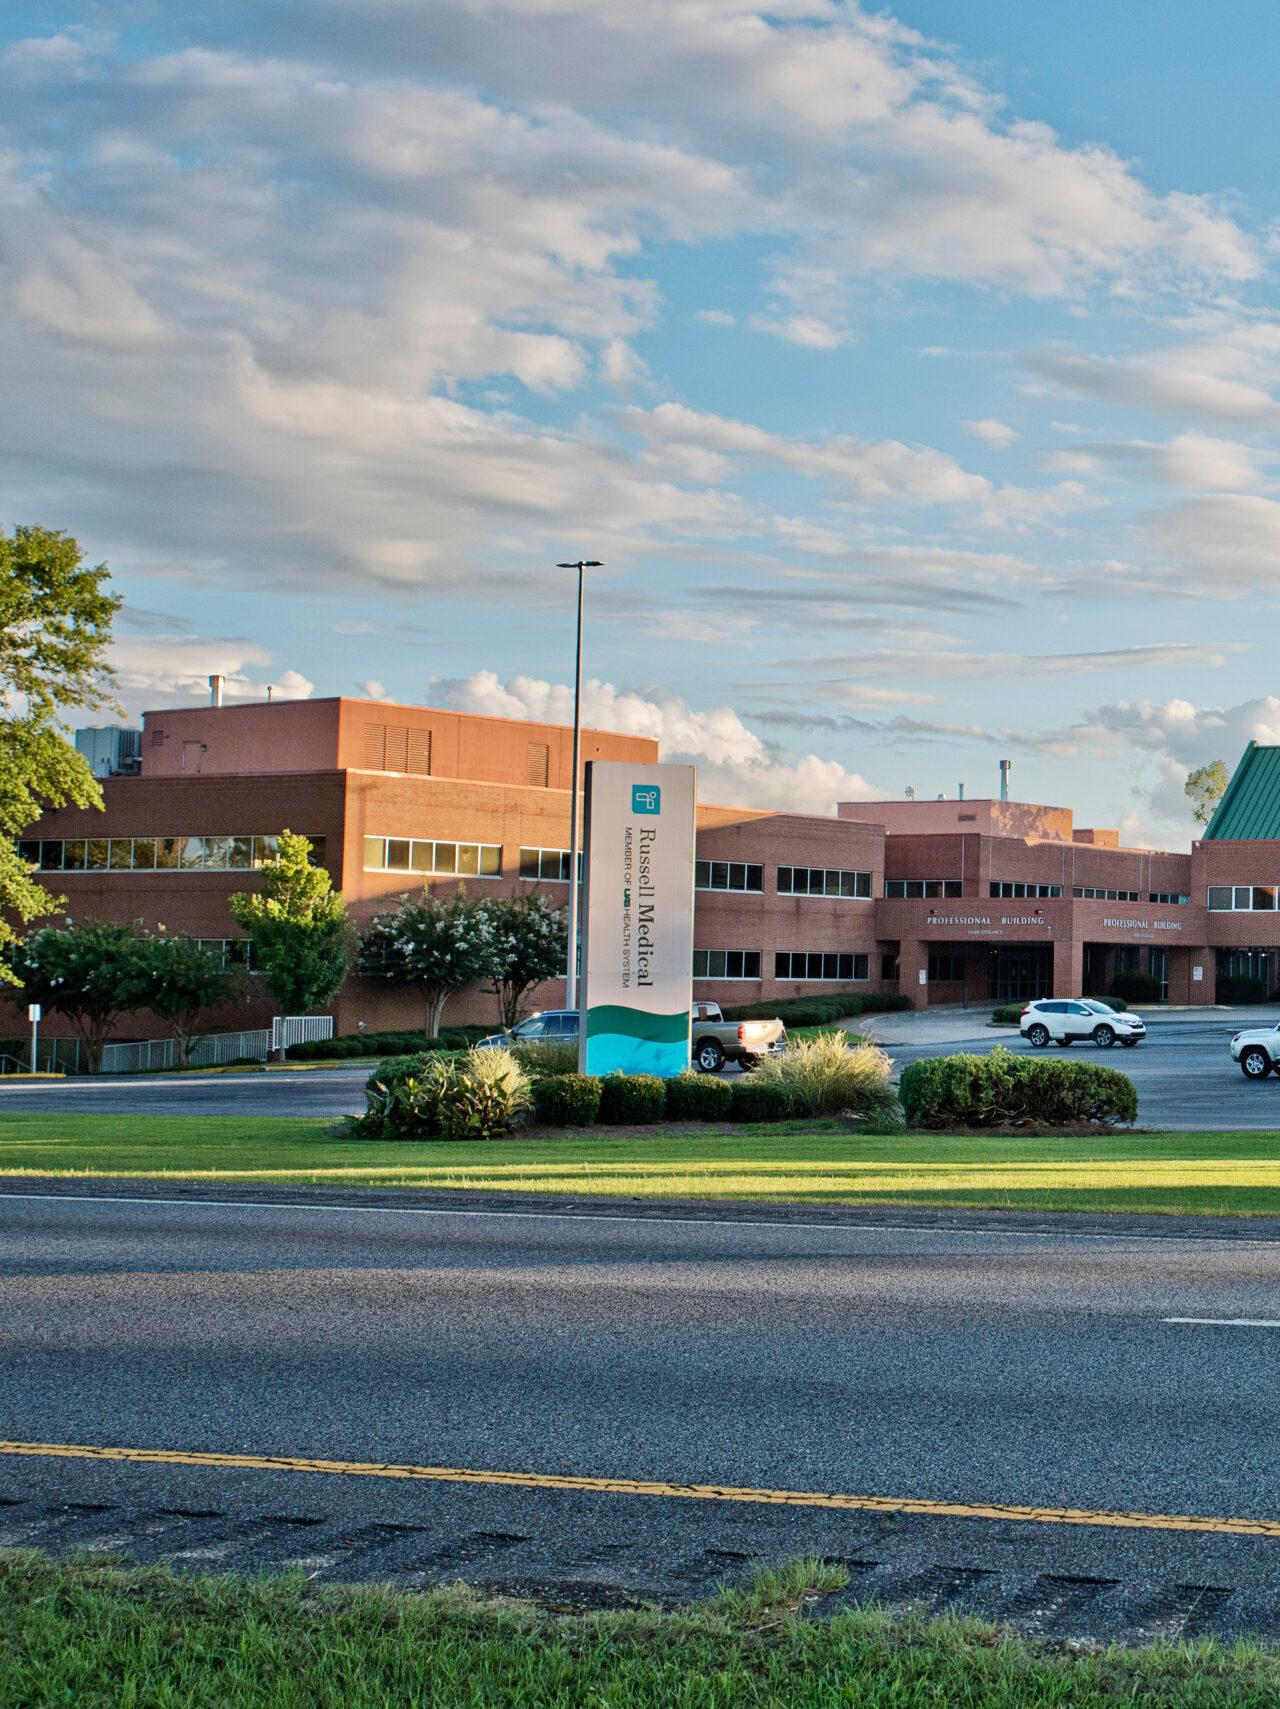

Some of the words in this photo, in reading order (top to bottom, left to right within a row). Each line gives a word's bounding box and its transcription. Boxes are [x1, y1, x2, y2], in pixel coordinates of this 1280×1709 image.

[624, 827, 633, 870] MEMBER
[638, 827, 656, 897] Russell
[623, 888, 631, 908] UAB
[624, 872, 632, 886] OF
[623, 908, 631, 946] HEALTH
[927, 916, 992, 925] PROFESSIONAL
[1001, 916, 1045, 925] BUILDING
[1103, 918, 1149, 929] PROFESSIONAL
[1154, 921, 1182, 930] BUILDING
[637, 903, 655, 988] Medical
[622, 949, 630, 988] SYSTEM
